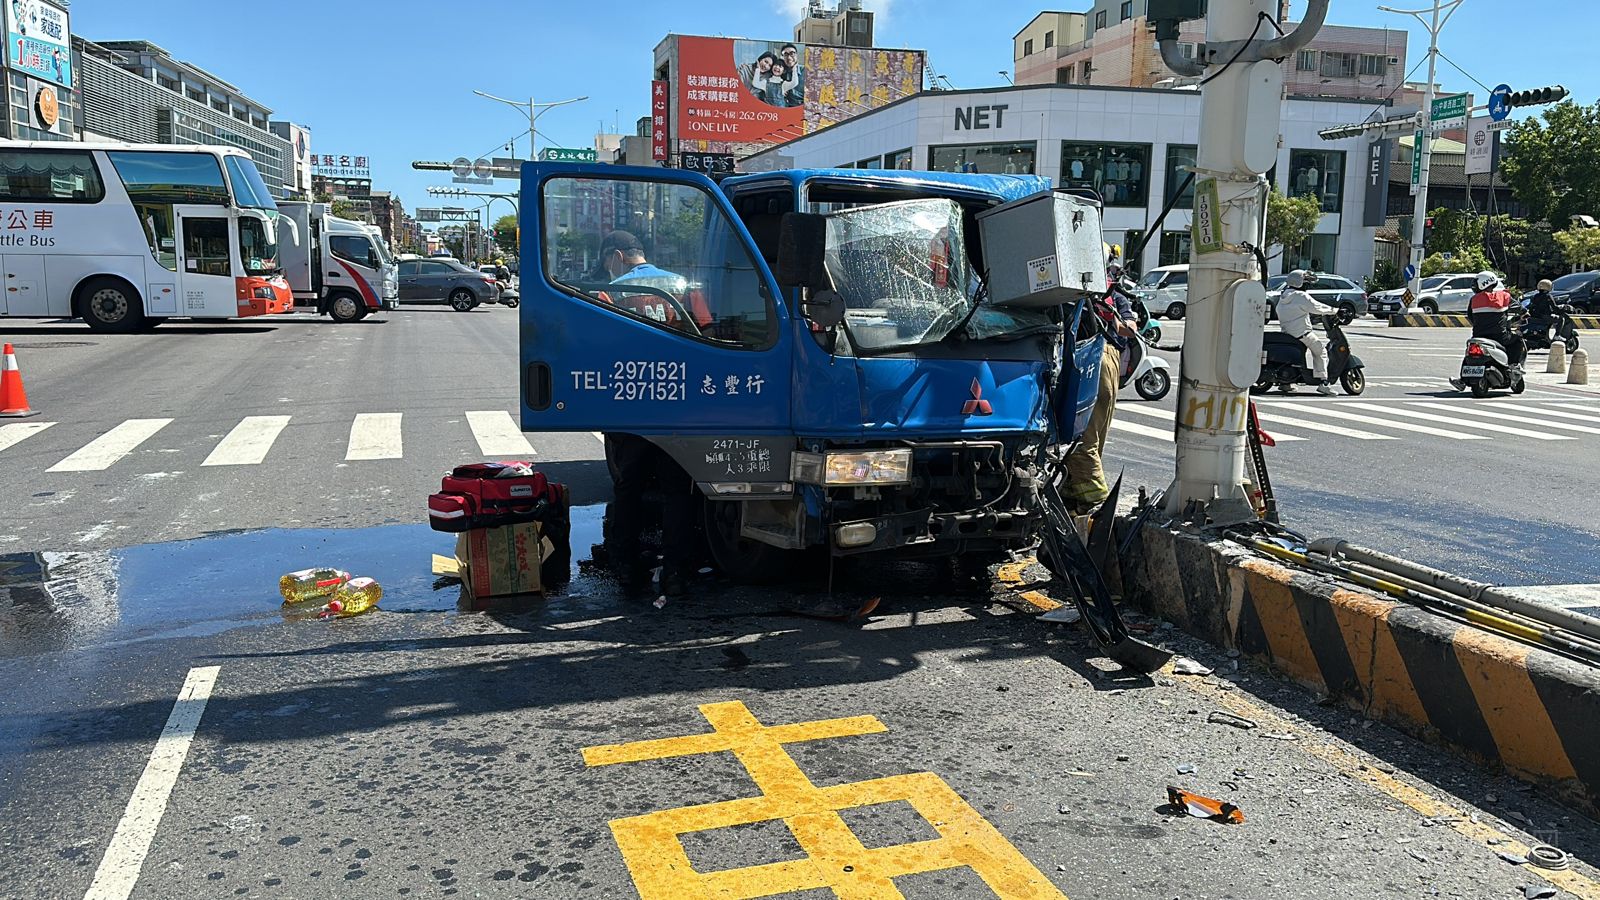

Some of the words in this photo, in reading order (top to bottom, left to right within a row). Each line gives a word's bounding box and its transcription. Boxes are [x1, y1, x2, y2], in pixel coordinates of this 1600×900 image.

[687, 74, 739, 89] 裝潢應援你
[687, 90, 739, 104] 成家購輕鬆
[655, 84, 664, 156] 美心排骨飯
[739, 110, 755, 121] 262
[756, 111, 778, 122] 6798
[954, 104, 1008, 131] NET
[692, 121, 716, 133] ONE
[717, 122, 739, 133] LIVE
[559, 152, 594, 161] 土地銀行
[1371, 145, 1380, 185] NET
[1200, 195, 1211, 244] 190210
[0, 234, 24, 247] ttle
[31, 234, 55, 247] Bus
[614, 361, 686, 380] 2971521
[571, 371, 613, 390] TEL:
[701, 374, 765, 395] 志豐行
[614, 382, 686, 400] 2971521
[713, 439, 760, 449] 2471-JF
